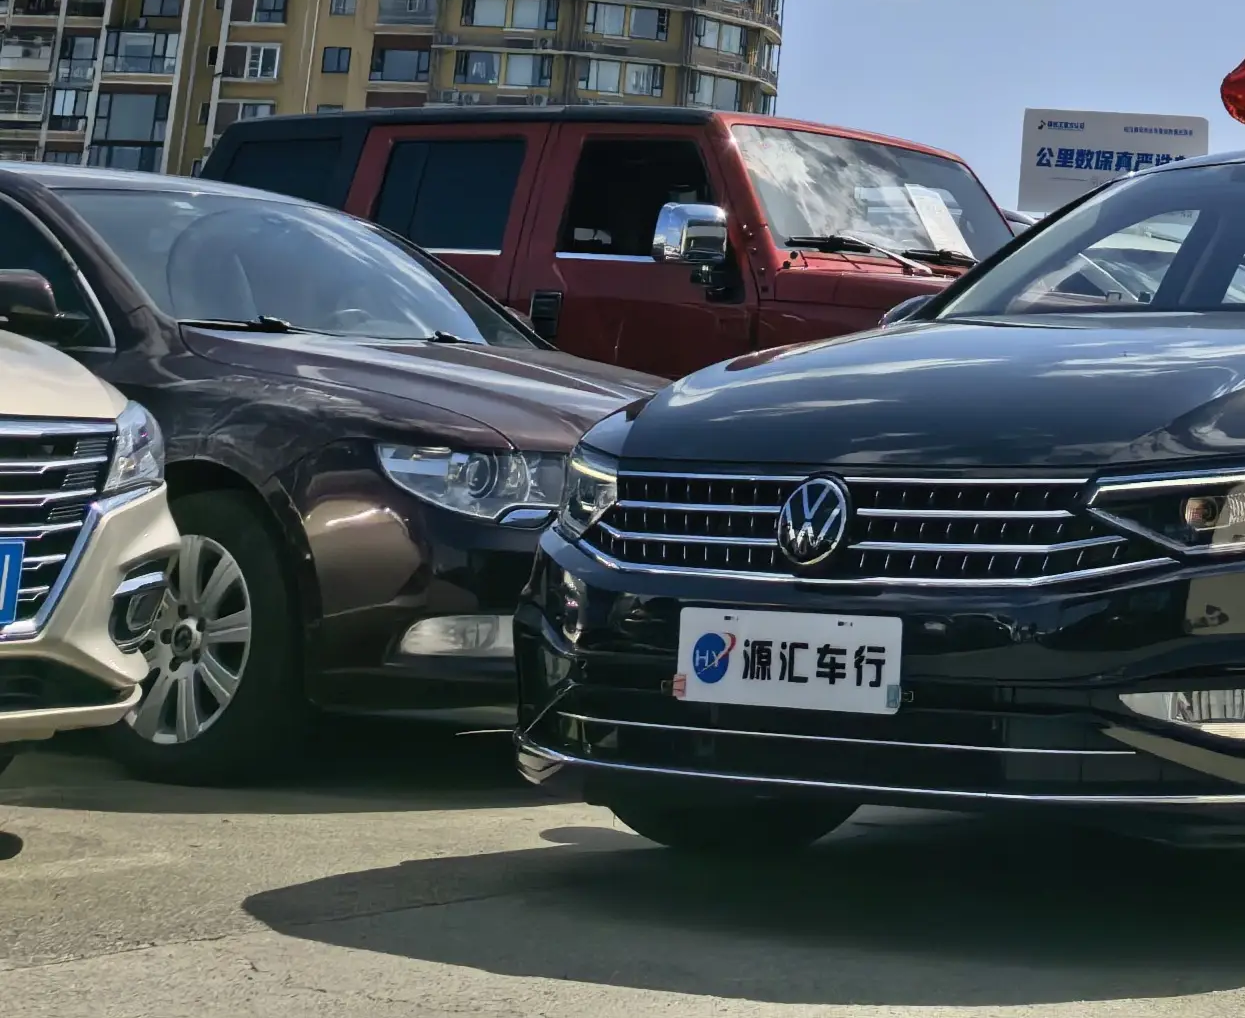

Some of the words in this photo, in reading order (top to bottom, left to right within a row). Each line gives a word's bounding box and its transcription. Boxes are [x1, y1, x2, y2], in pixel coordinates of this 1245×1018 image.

[1036, 147, 1187, 171] 公里数保真严选
[742, 639, 886, 688] 源汇车行
